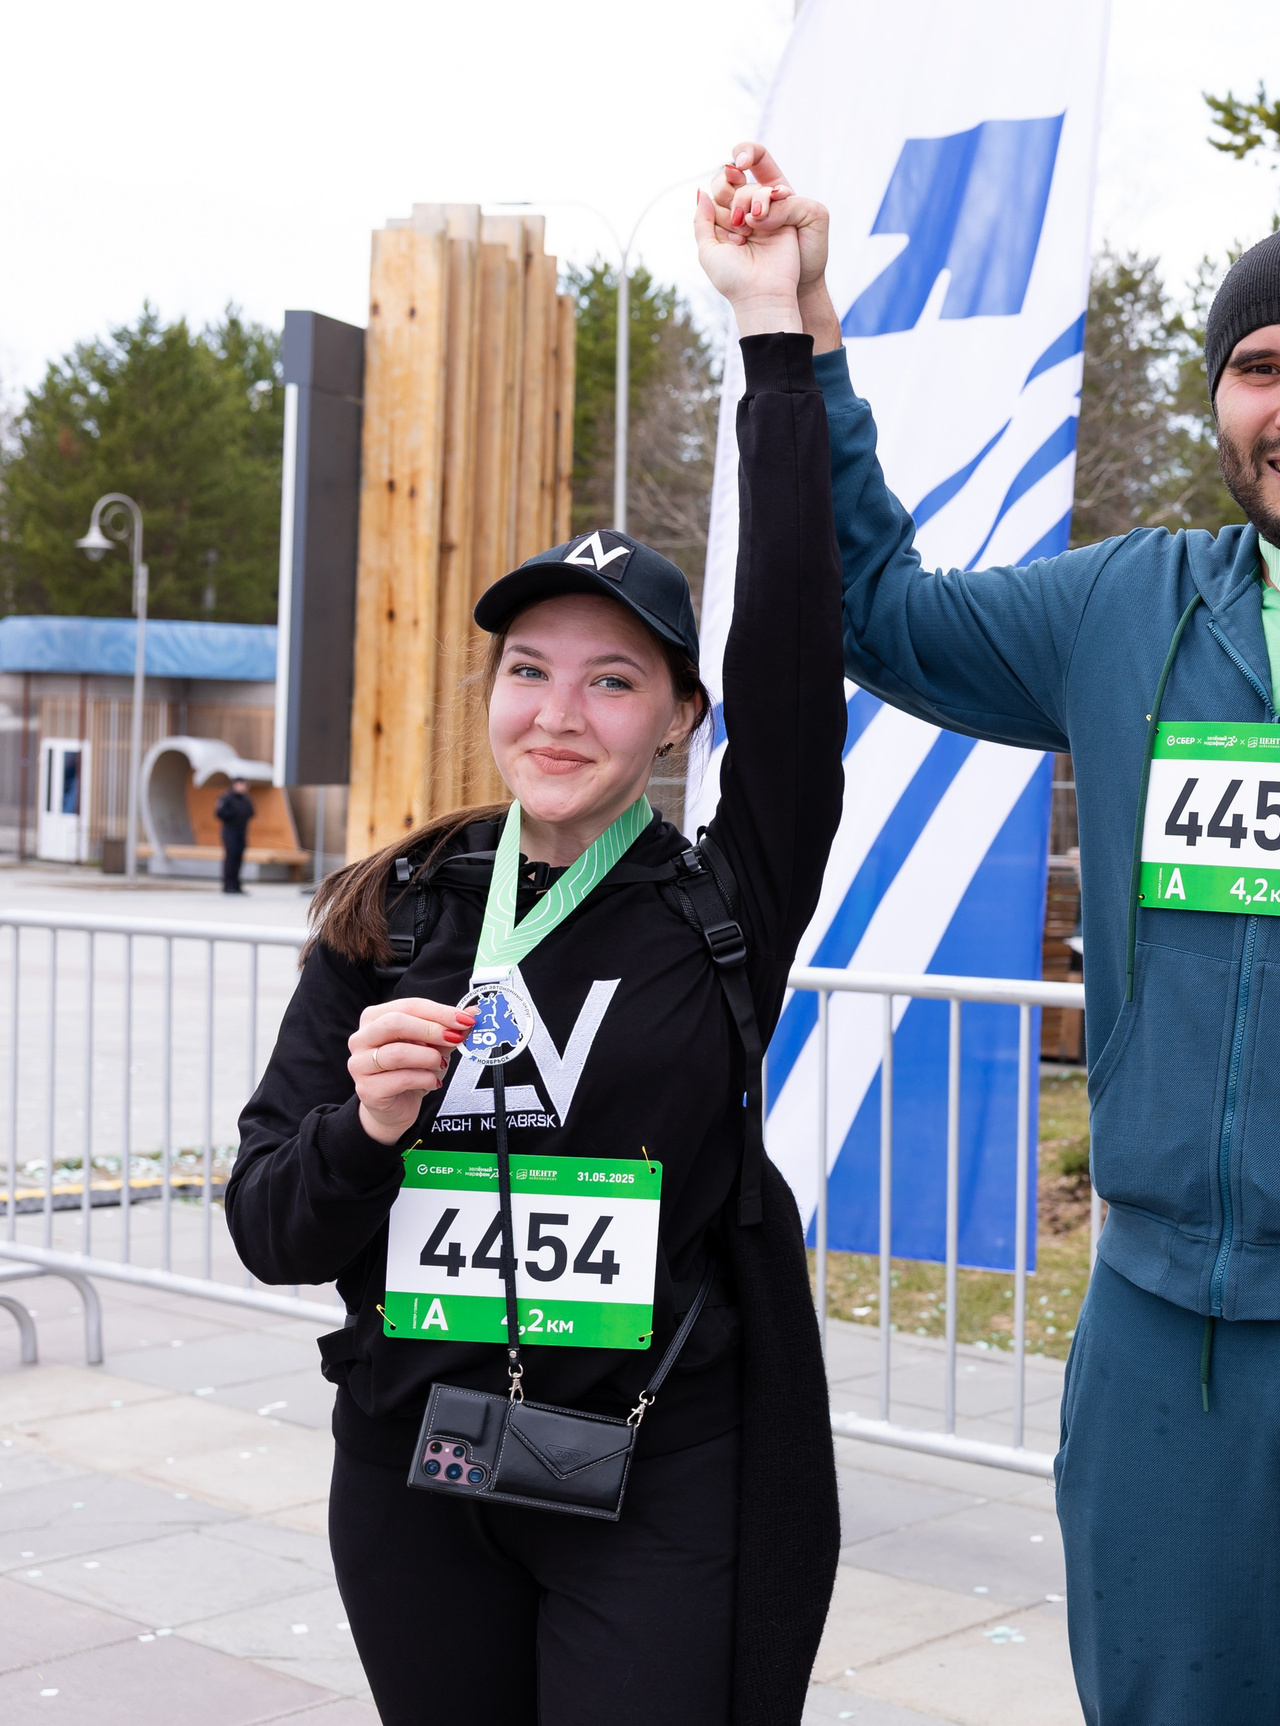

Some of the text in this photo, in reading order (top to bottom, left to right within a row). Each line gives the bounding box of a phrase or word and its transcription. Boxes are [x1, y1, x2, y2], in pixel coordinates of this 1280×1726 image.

[1175, 736, 1196, 745] СБЕР
[1229, 876, 1269, 905] 4,2
[472, 1032, 497, 1046] 50
[431, 1113, 557, 1133] ARCH NOABRSK
[429, 1166, 454, 1175] СБЕР
[529, 1169, 558, 1178] ЦЕНТР
[577, 1171, 635, 1184] 31.05.2025
[419, 1207, 621, 1285] 4454
[500, 1308, 544, 1336] ,2
